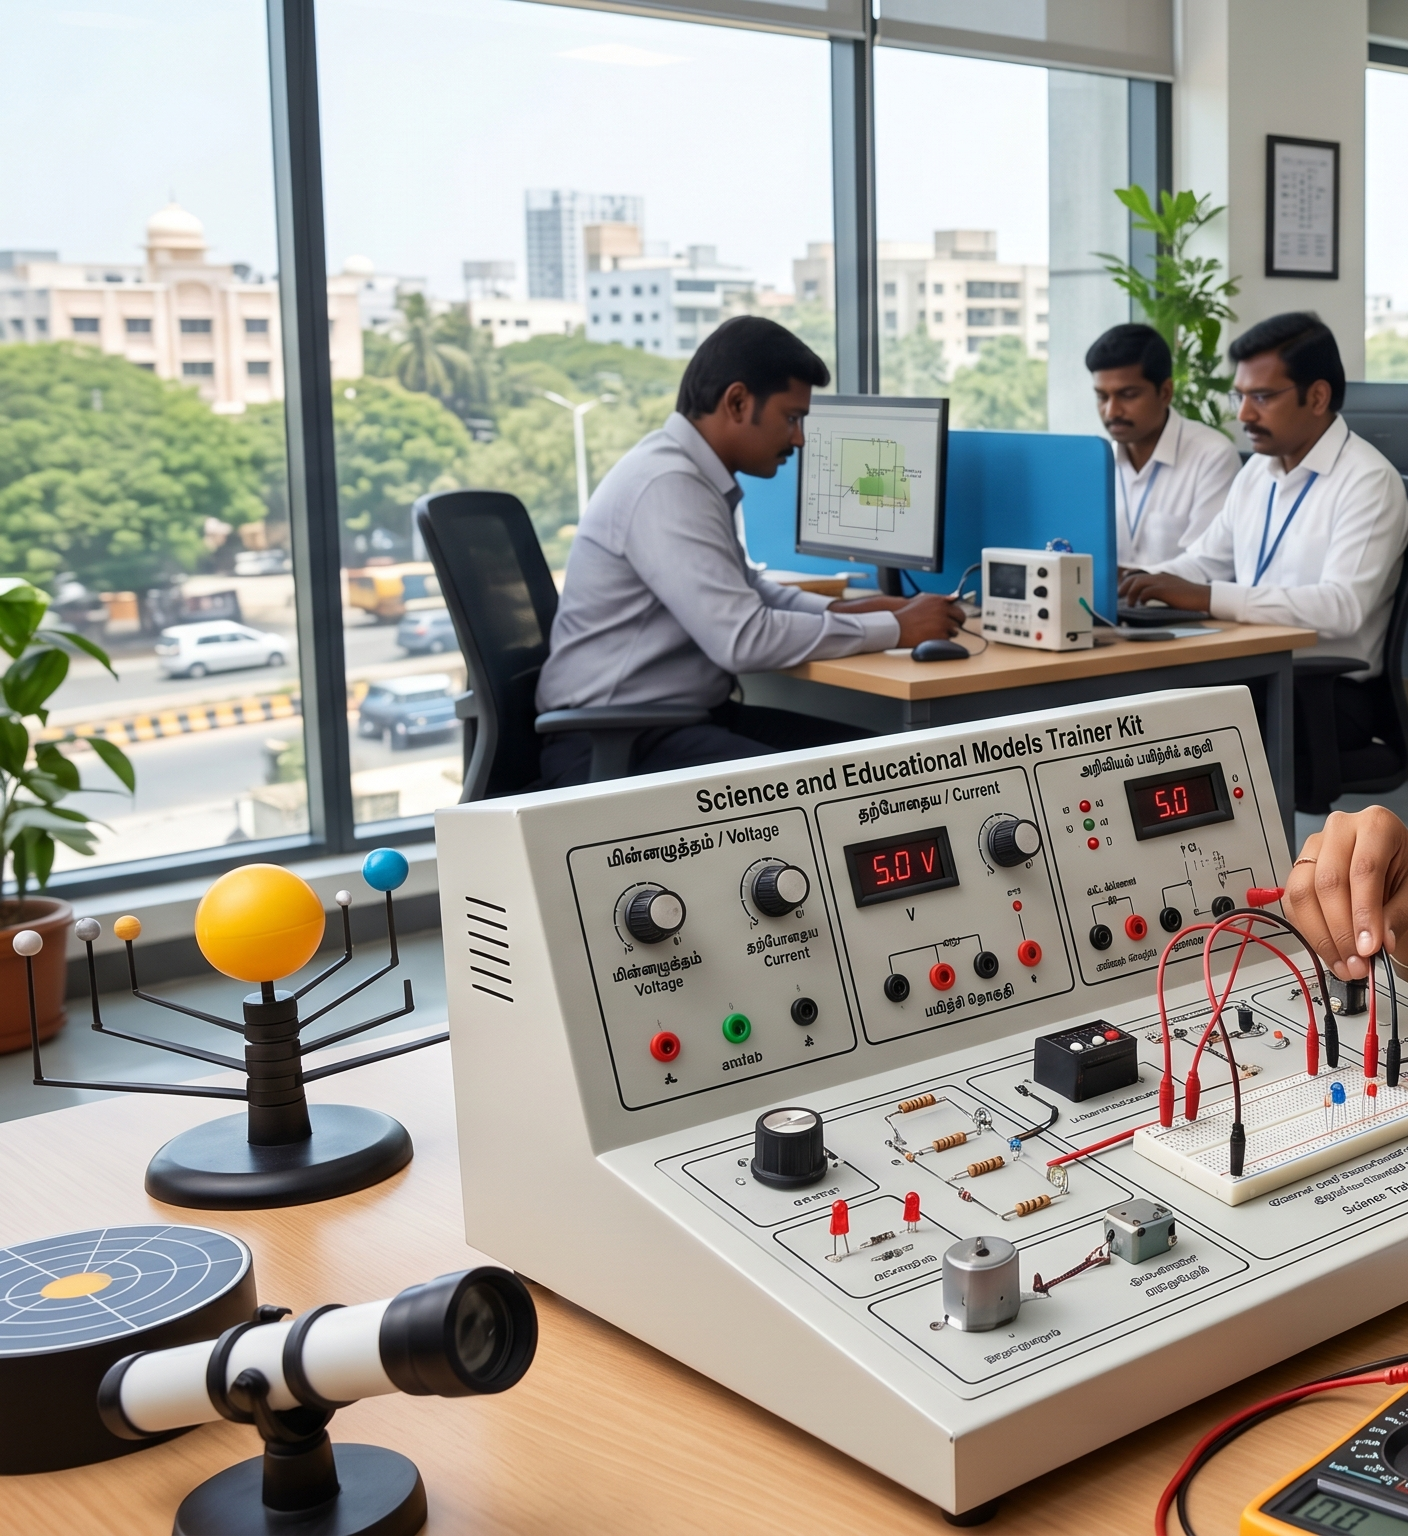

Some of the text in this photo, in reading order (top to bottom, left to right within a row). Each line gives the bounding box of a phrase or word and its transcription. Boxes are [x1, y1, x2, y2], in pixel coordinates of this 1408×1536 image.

[696, 715, 1144, 813] Science and Educational Models Trainer Kit
[953, 781, 1000, 801] Current
[1155, 786, 1188, 818] 5.0
[607, 833, 714, 867] மின்னழுத்தம்
[726, 825, 779, 844] Voltage
[873, 847, 935, 885] 5.0 V
[906, 907, 914, 921] V
[764, 947, 811, 967] Current
[634, 973, 683, 996] Voltage
